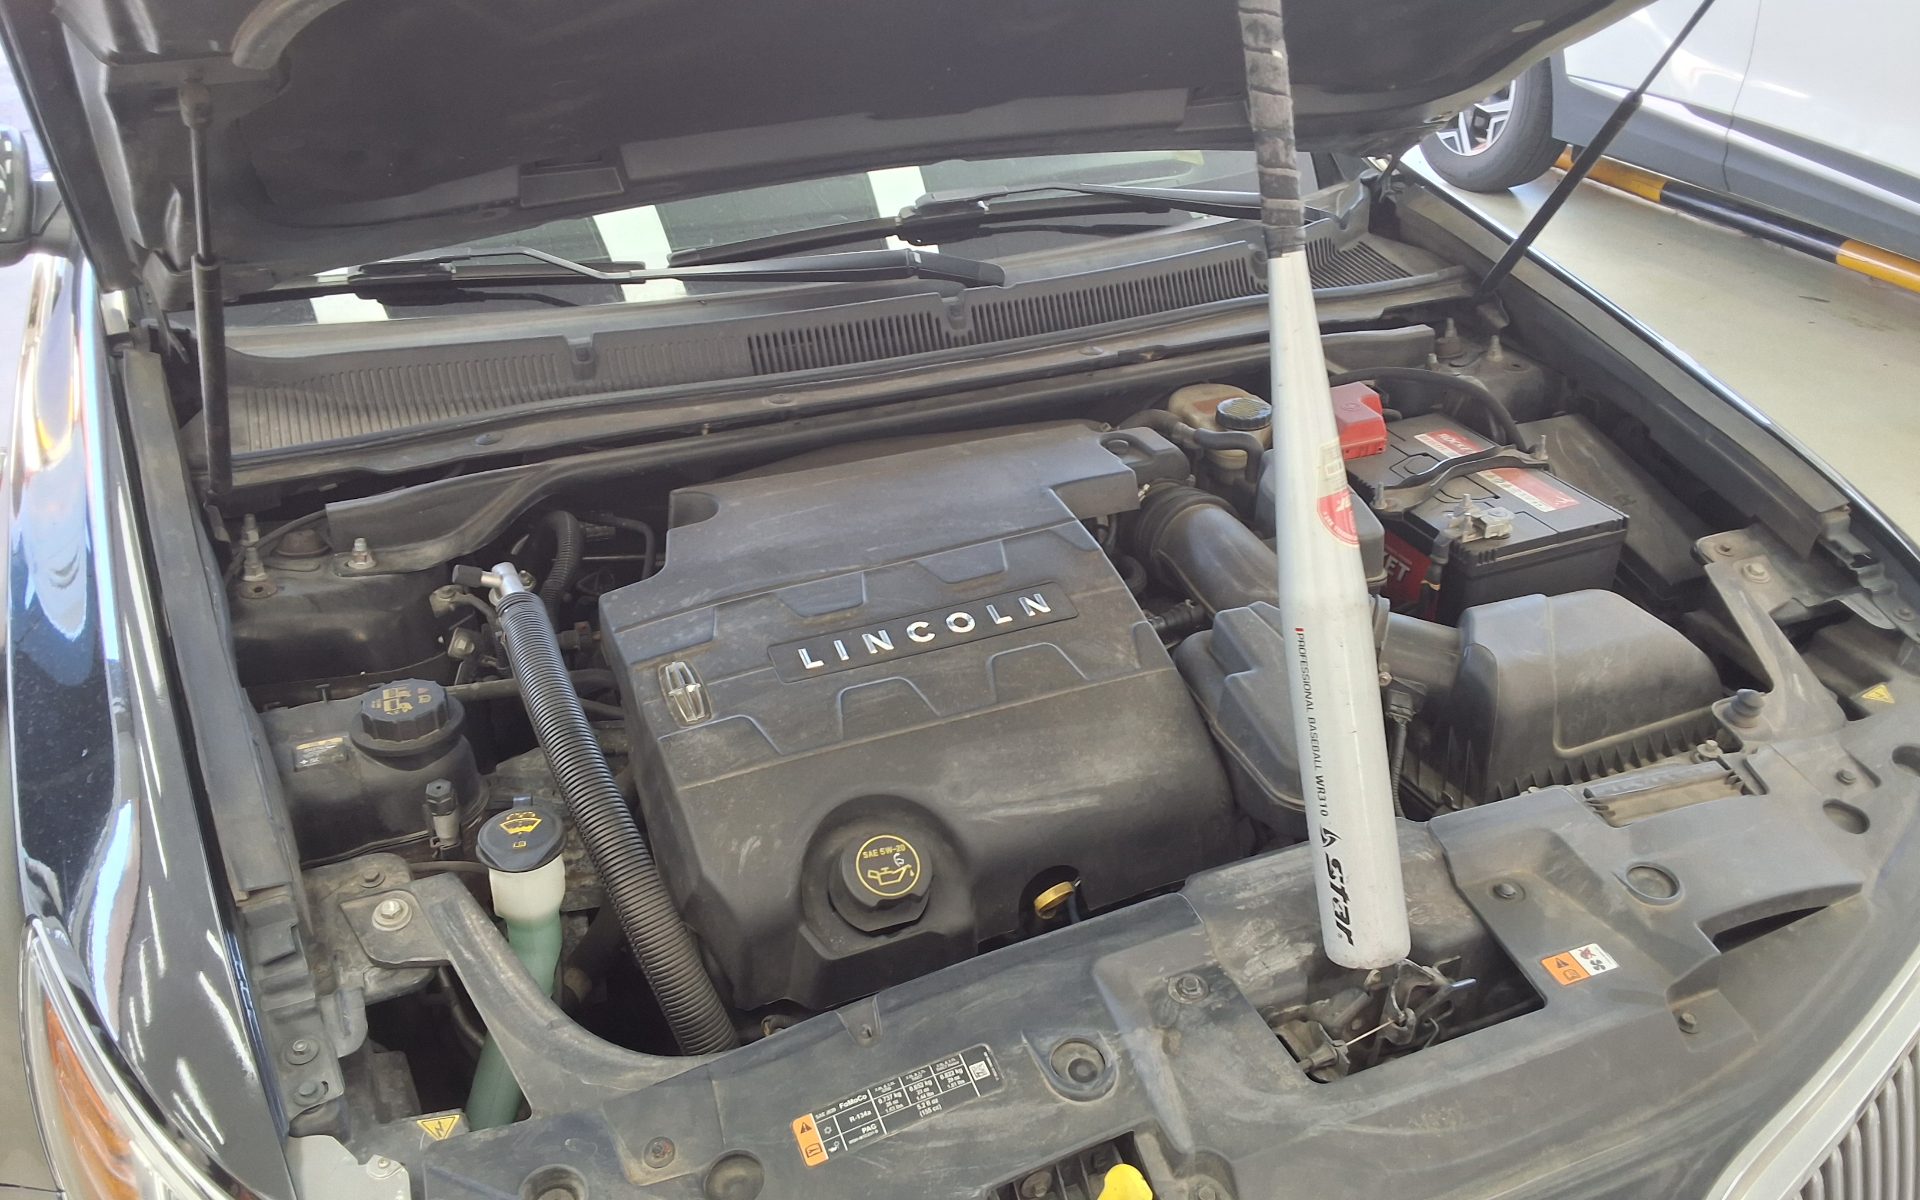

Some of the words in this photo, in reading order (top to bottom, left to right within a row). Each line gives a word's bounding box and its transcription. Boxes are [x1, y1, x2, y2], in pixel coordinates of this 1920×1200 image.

[798, 593, 1051, 669] LINCOLN
[1297, 633, 1315, 711] PROFESSIONAL
[1307, 716, 1323, 771] BASEBALL
[1315, 774, 1330, 817] WR310
[862, 849, 879, 859] SAE
[879, 844, 906, 856] 5W-20
[838, 1094, 868, 1110] FoMoCo
[849, 1110, 872, 1123] R-134a
[861, 1123, 878, 1134] PAG
